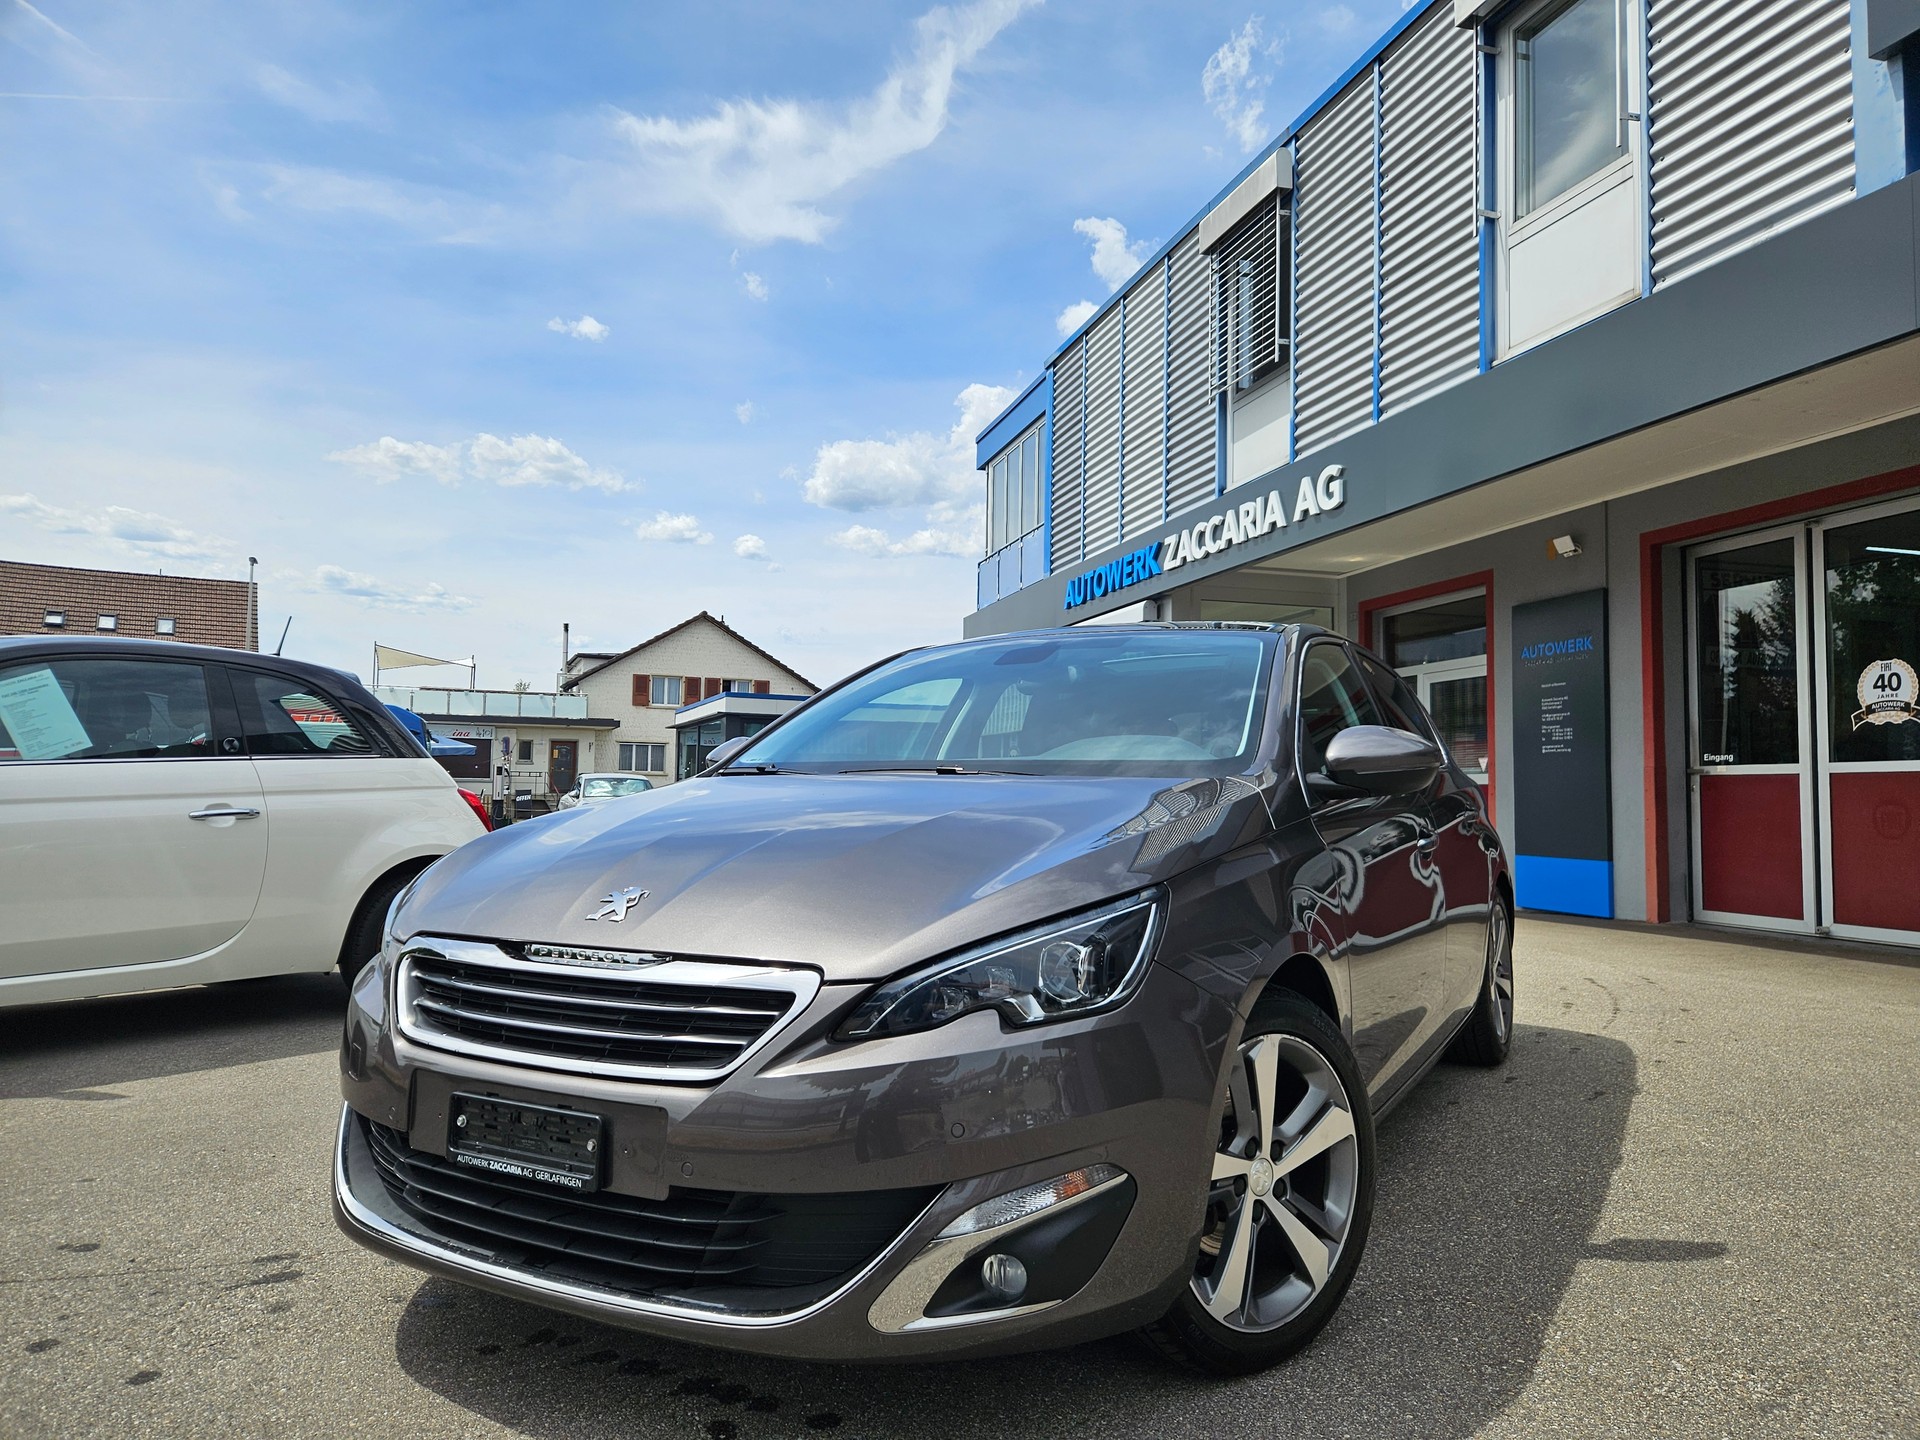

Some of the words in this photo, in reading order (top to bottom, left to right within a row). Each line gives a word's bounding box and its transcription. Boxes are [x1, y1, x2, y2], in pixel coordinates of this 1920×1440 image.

[1064, 541, 1163, 609] AUTOWERK
[1163, 490, 1287, 571] ZACCARIA
[1293, 464, 1345, 522] AG
[1521, 636, 1594, 660] AUTOWERK
[1880, 662, 1892, 672] FIAT
[1872, 672, 1902, 692] 40
[1871, 701, 1905, 710] AUTOWERK
[1703, 753, 1734, 763] Eingang
[539, 946, 628, 964] PEUGEOT
[457, 1154, 489, 1168] AUTOWERK
[489, 1161, 522, 1175] ZACCARIA
[522, 1168, 533, 1178] AG
[535, 1170, 582, 1188] GERLAFINGEN
